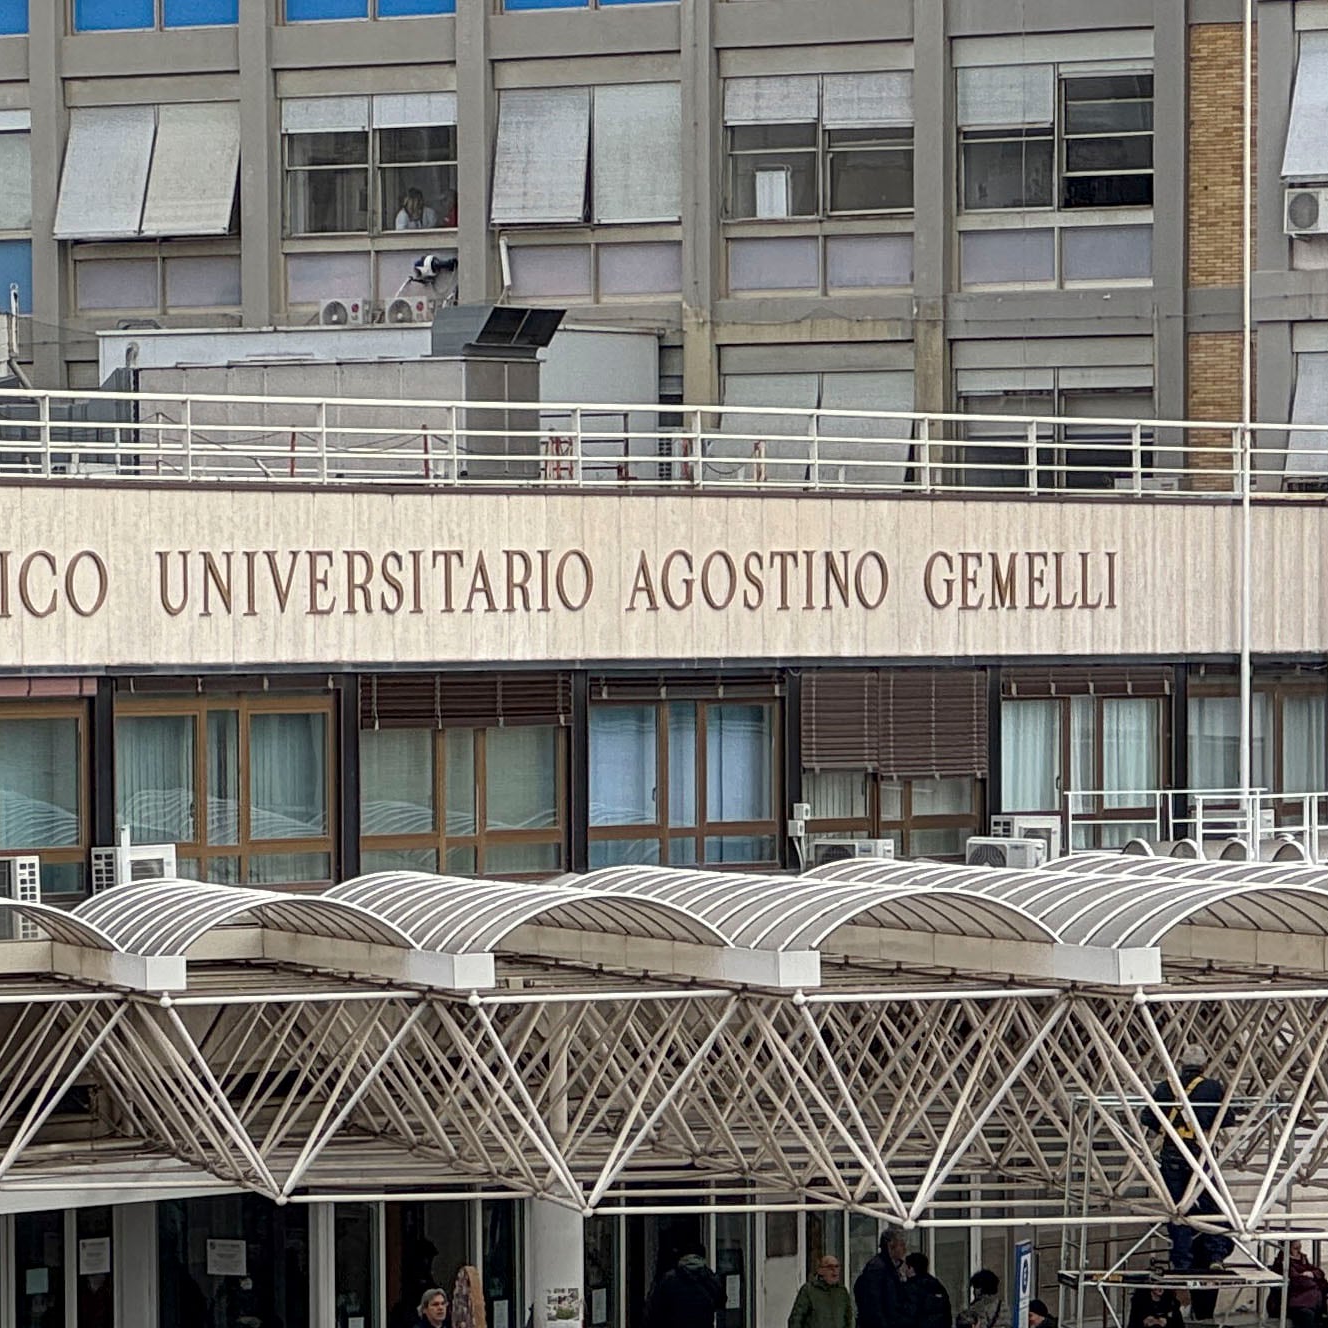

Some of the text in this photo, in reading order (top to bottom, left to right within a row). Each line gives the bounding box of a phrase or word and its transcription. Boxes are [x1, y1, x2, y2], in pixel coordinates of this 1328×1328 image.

[155, 548, 593, 616] UNIVERSITARIO
[626, 548, 889, 613] AGOSTINO
[923, 549, 1118, 612] GEMELLI
